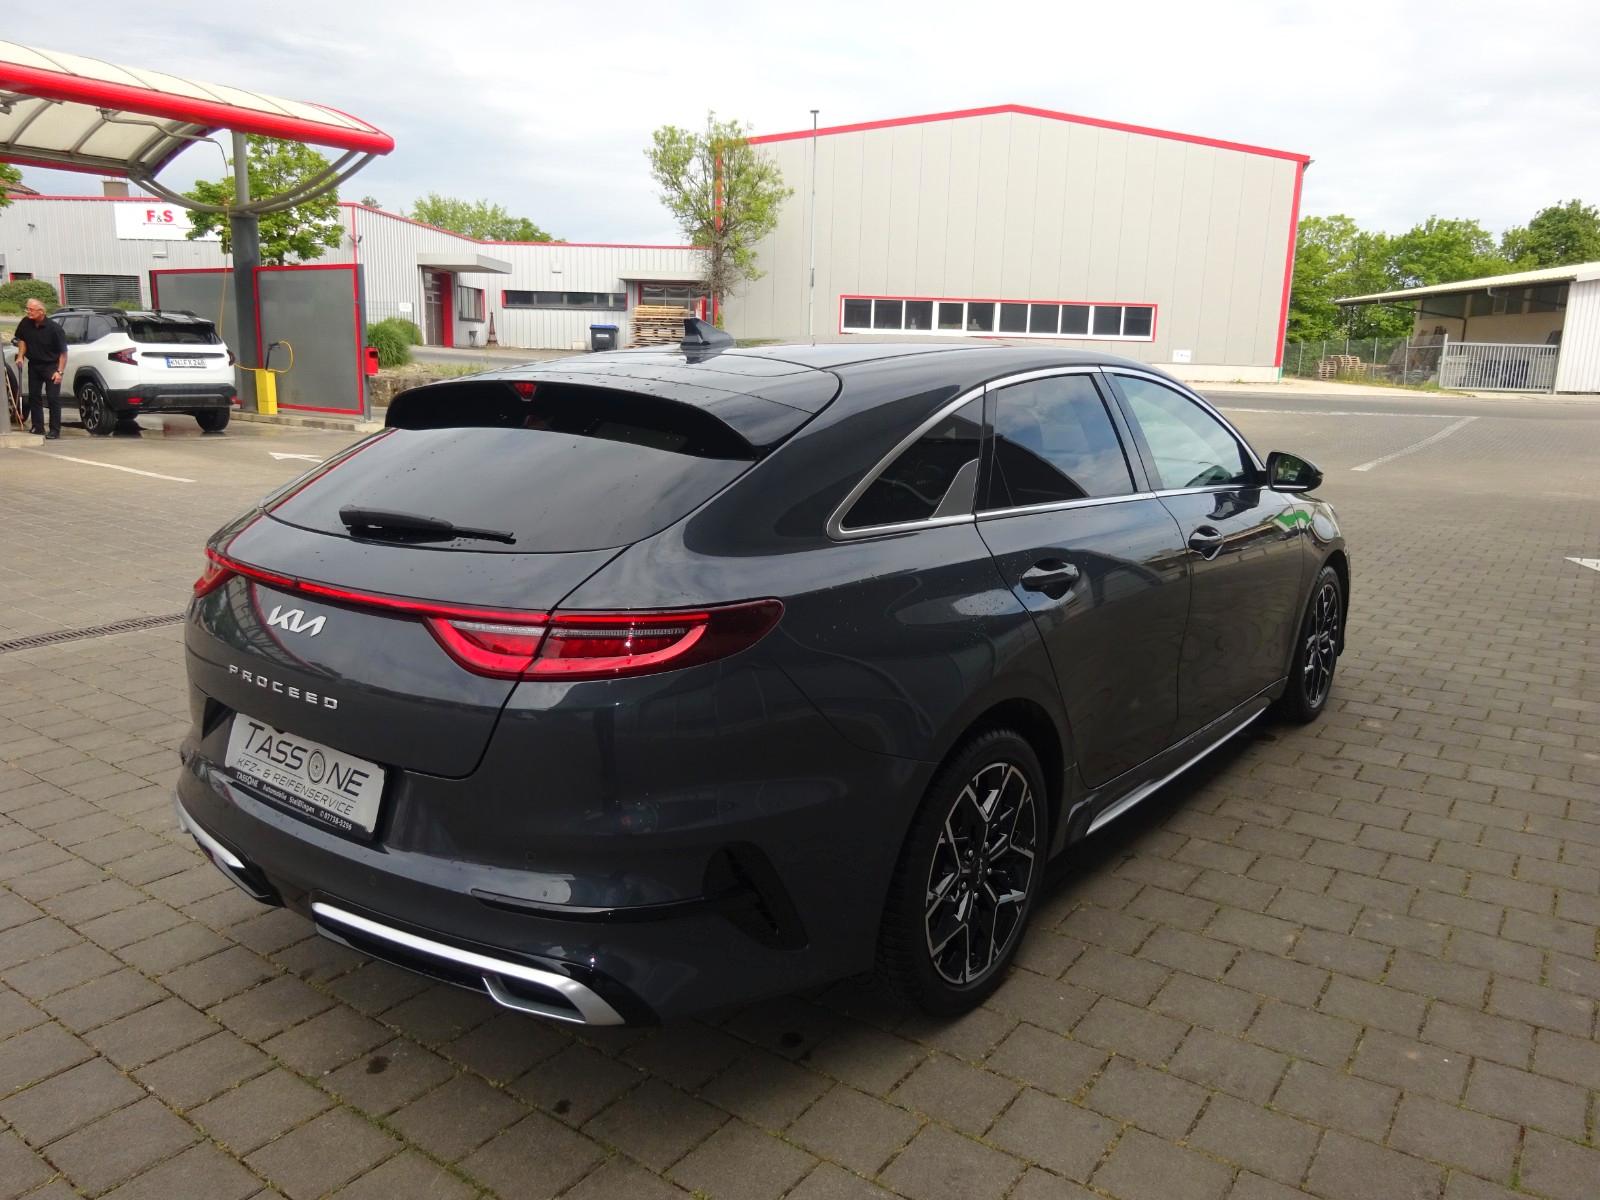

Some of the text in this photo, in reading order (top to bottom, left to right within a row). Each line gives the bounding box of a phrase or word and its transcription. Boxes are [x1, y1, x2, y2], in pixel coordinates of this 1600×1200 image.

[267, 605, 326, 637] KIA
[229, 664, 338, 710] PROCEED
[236, 771, 259, 788] TASSONE
[245, 721, 370, 797] TASSONE
[262, 768, 273, 779] &
[272, 773, 354, 816] REIFENSERVICE
